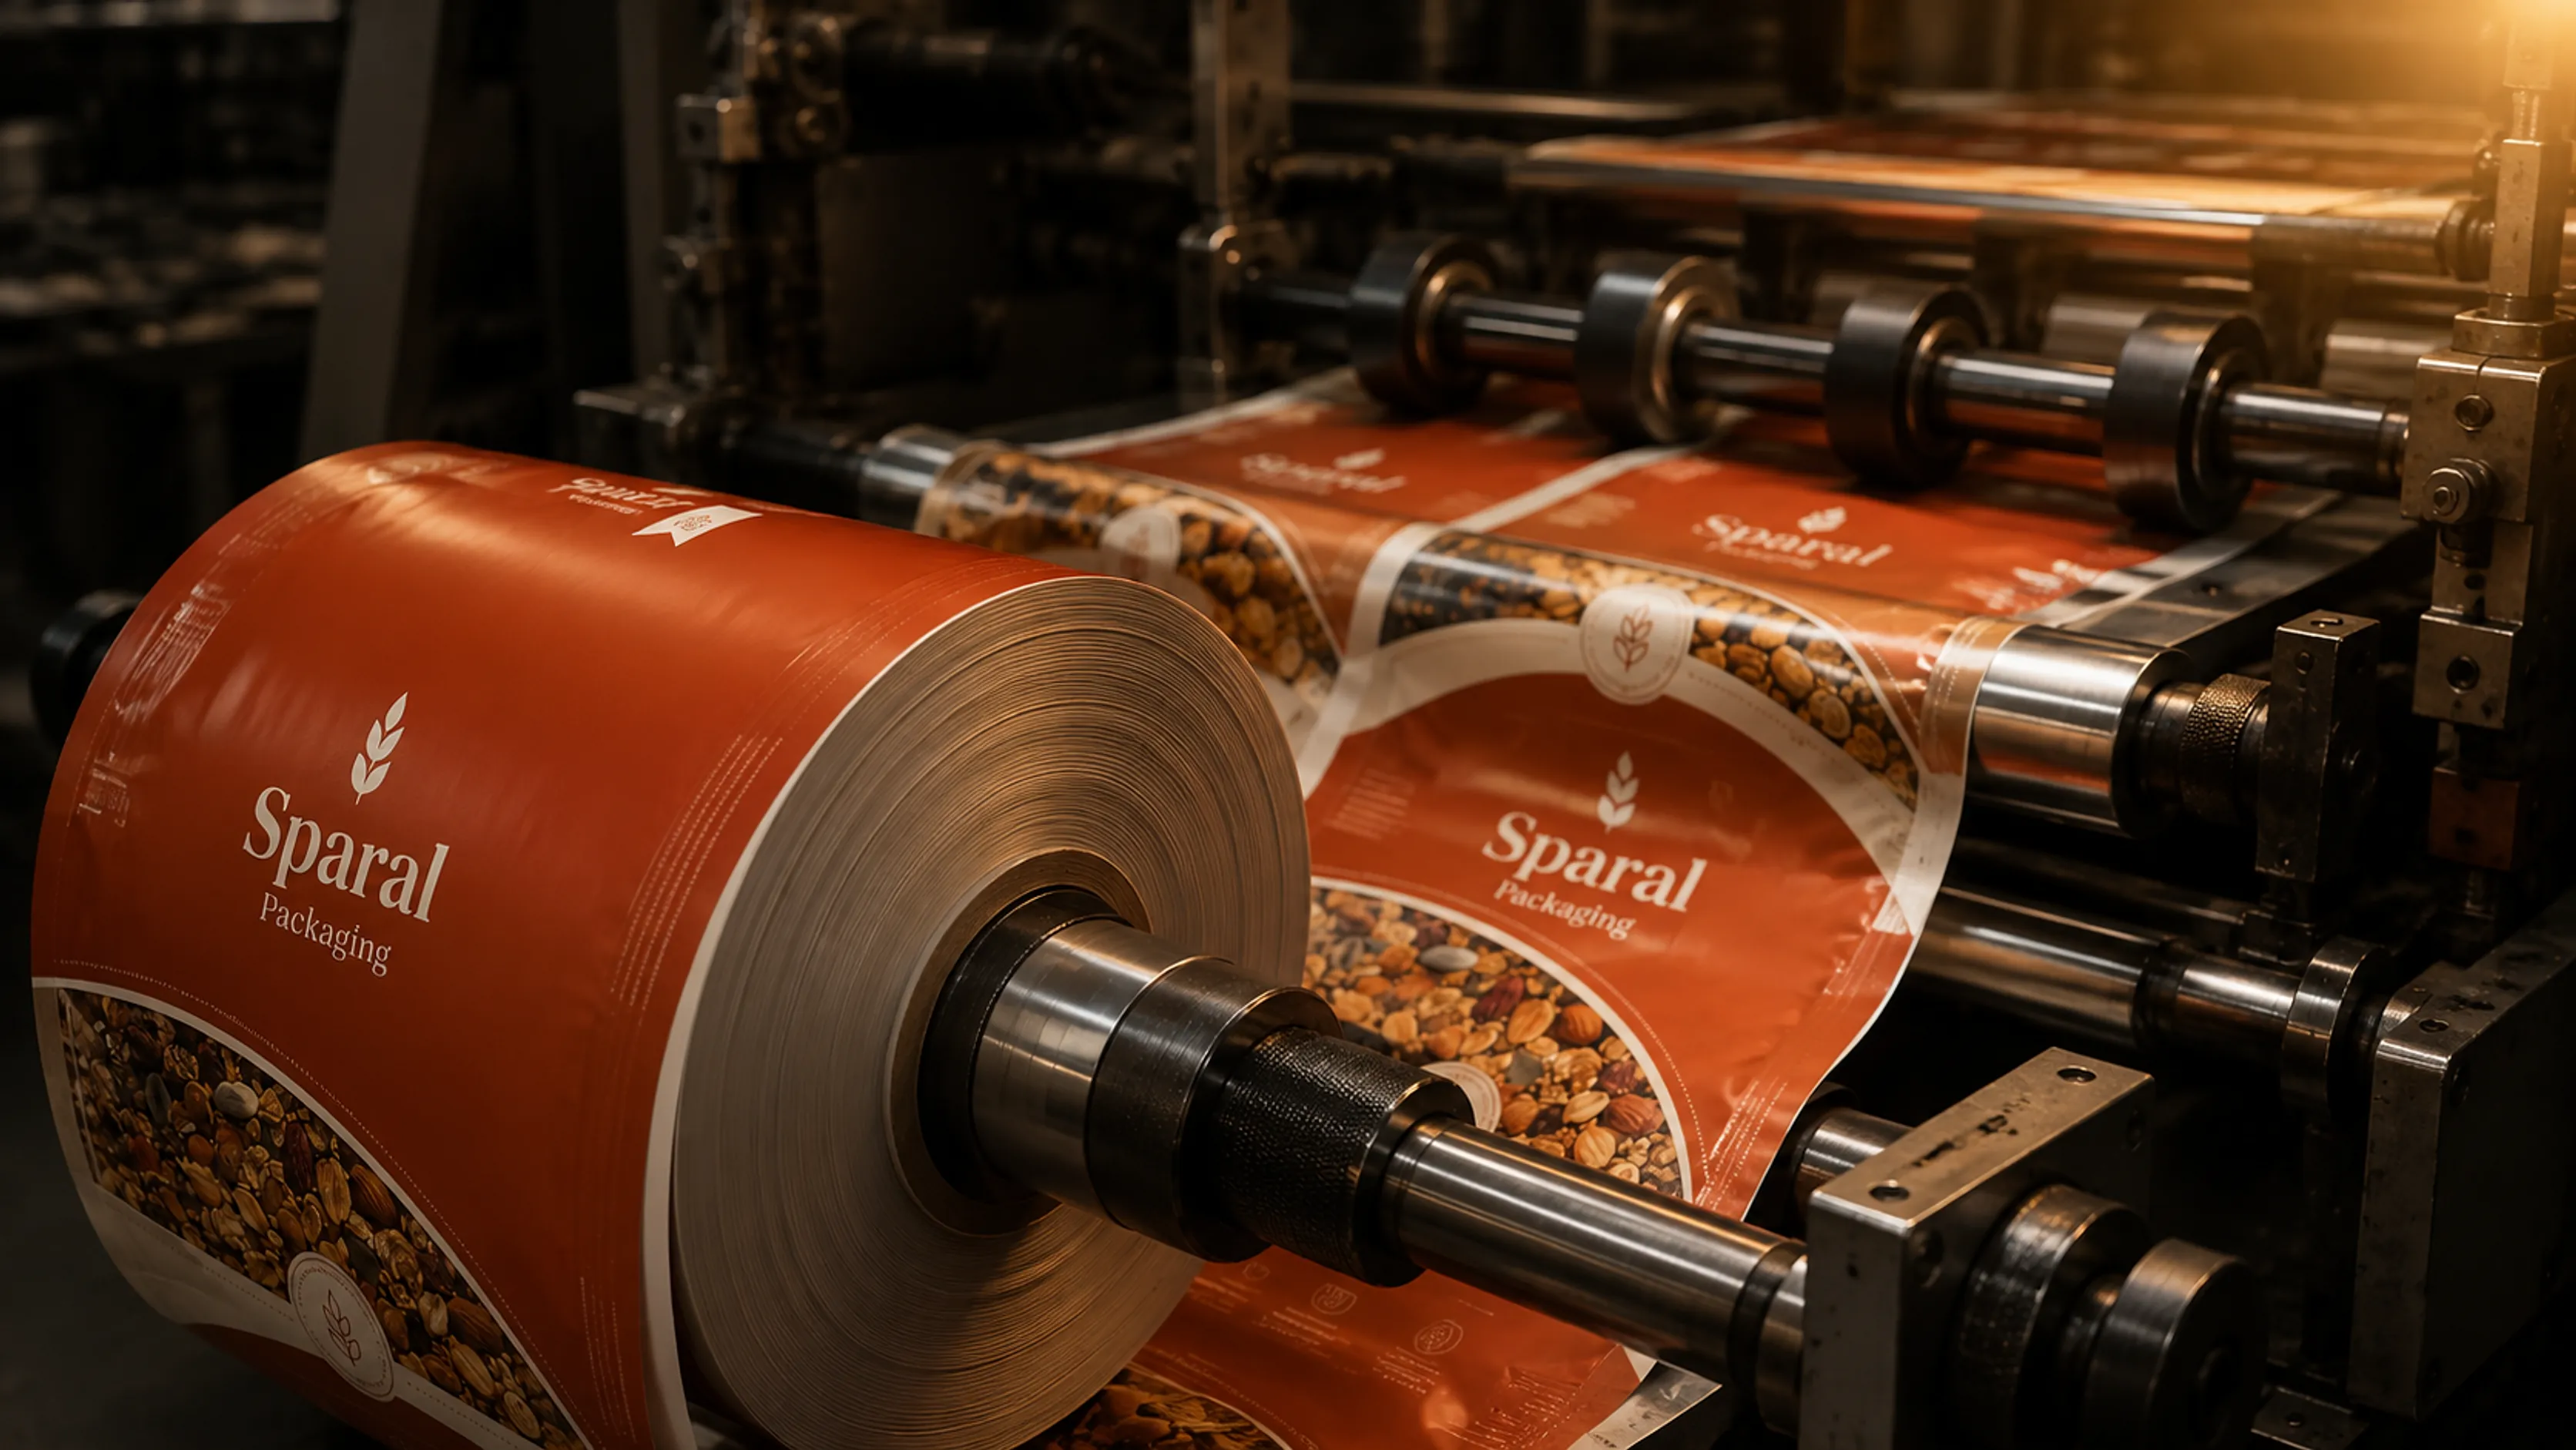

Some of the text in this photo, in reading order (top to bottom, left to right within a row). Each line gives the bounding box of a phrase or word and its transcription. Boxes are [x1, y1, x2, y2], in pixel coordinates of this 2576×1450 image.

[243, 787, 449, 921] Sparal
[1482, 812, 1707, 912] Sparal
[260, 892, 391, 976] Packaging
[1494, 879, 1635, 940] Packaging
